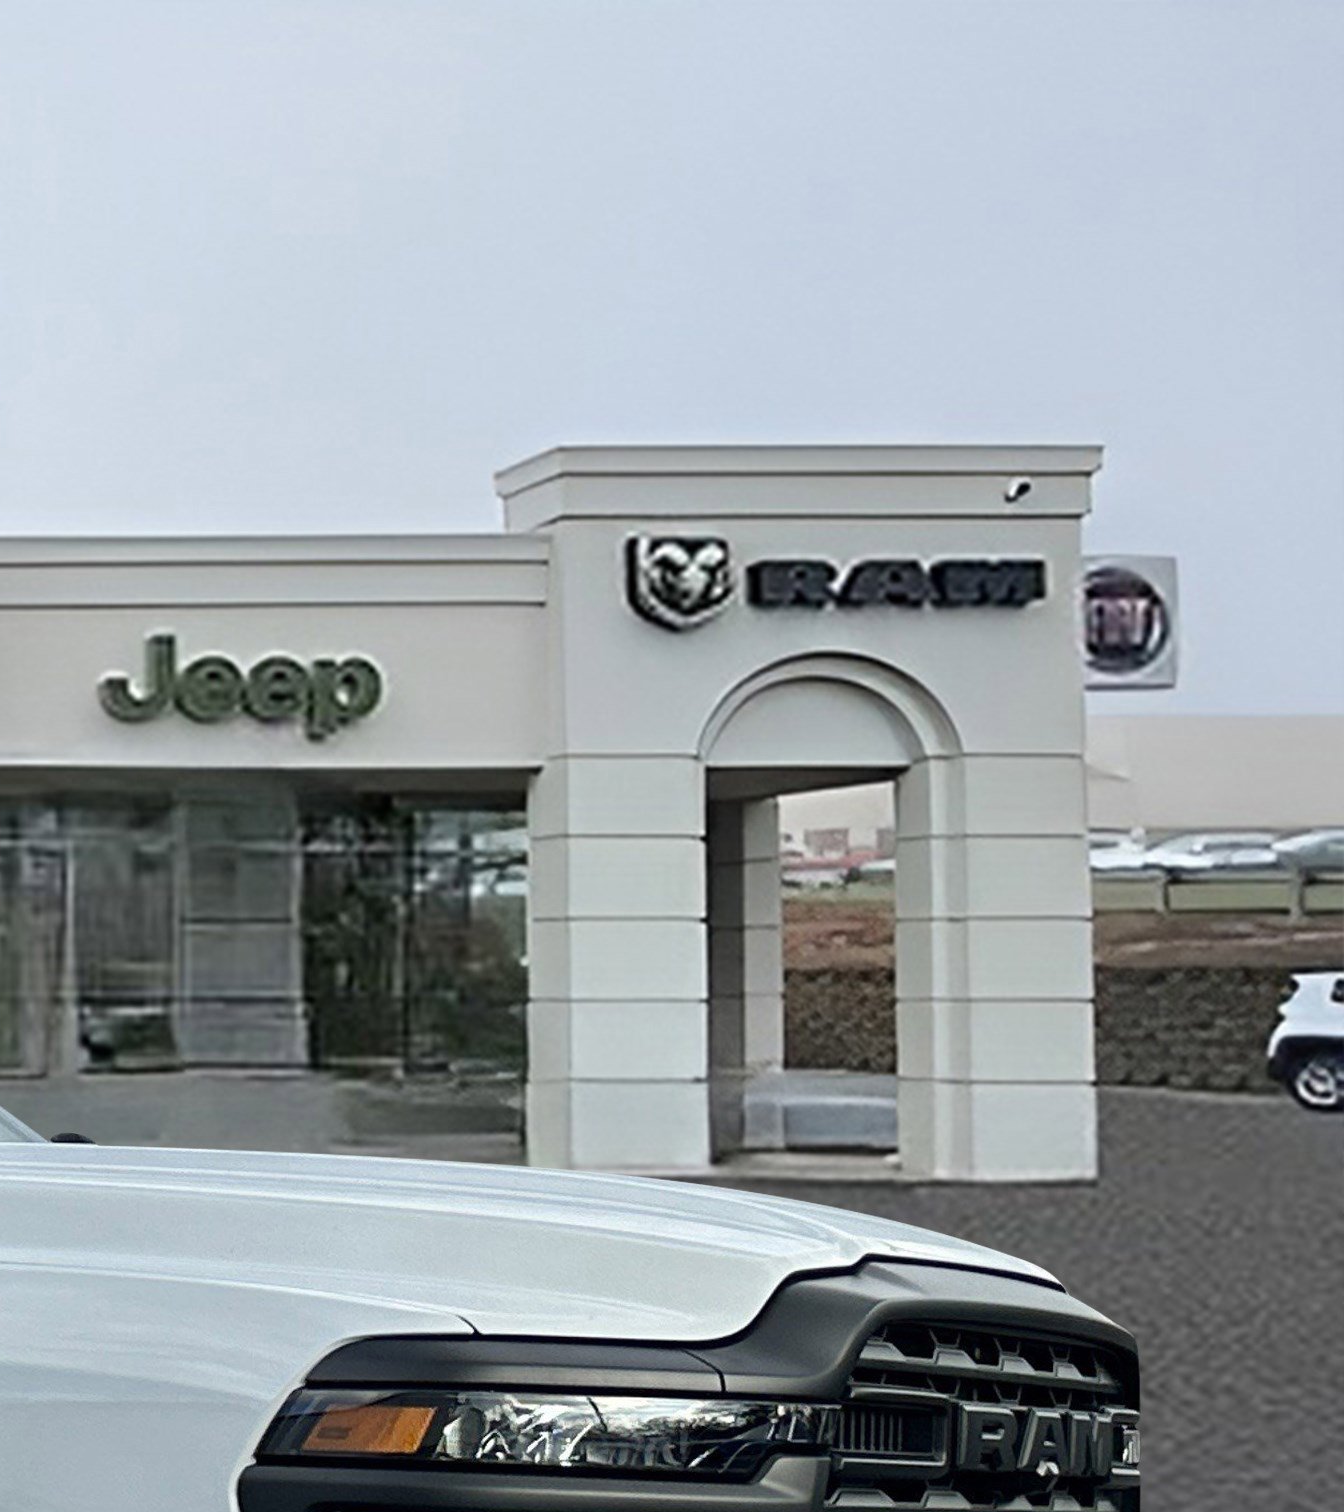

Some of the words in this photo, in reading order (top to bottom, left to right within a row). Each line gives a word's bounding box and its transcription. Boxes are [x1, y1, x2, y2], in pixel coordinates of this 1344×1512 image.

[746, 559, 1046, 608] RAM
[96, 631, 383, 742] Jeep
[957, 1403, 1113, 1478] RAM
